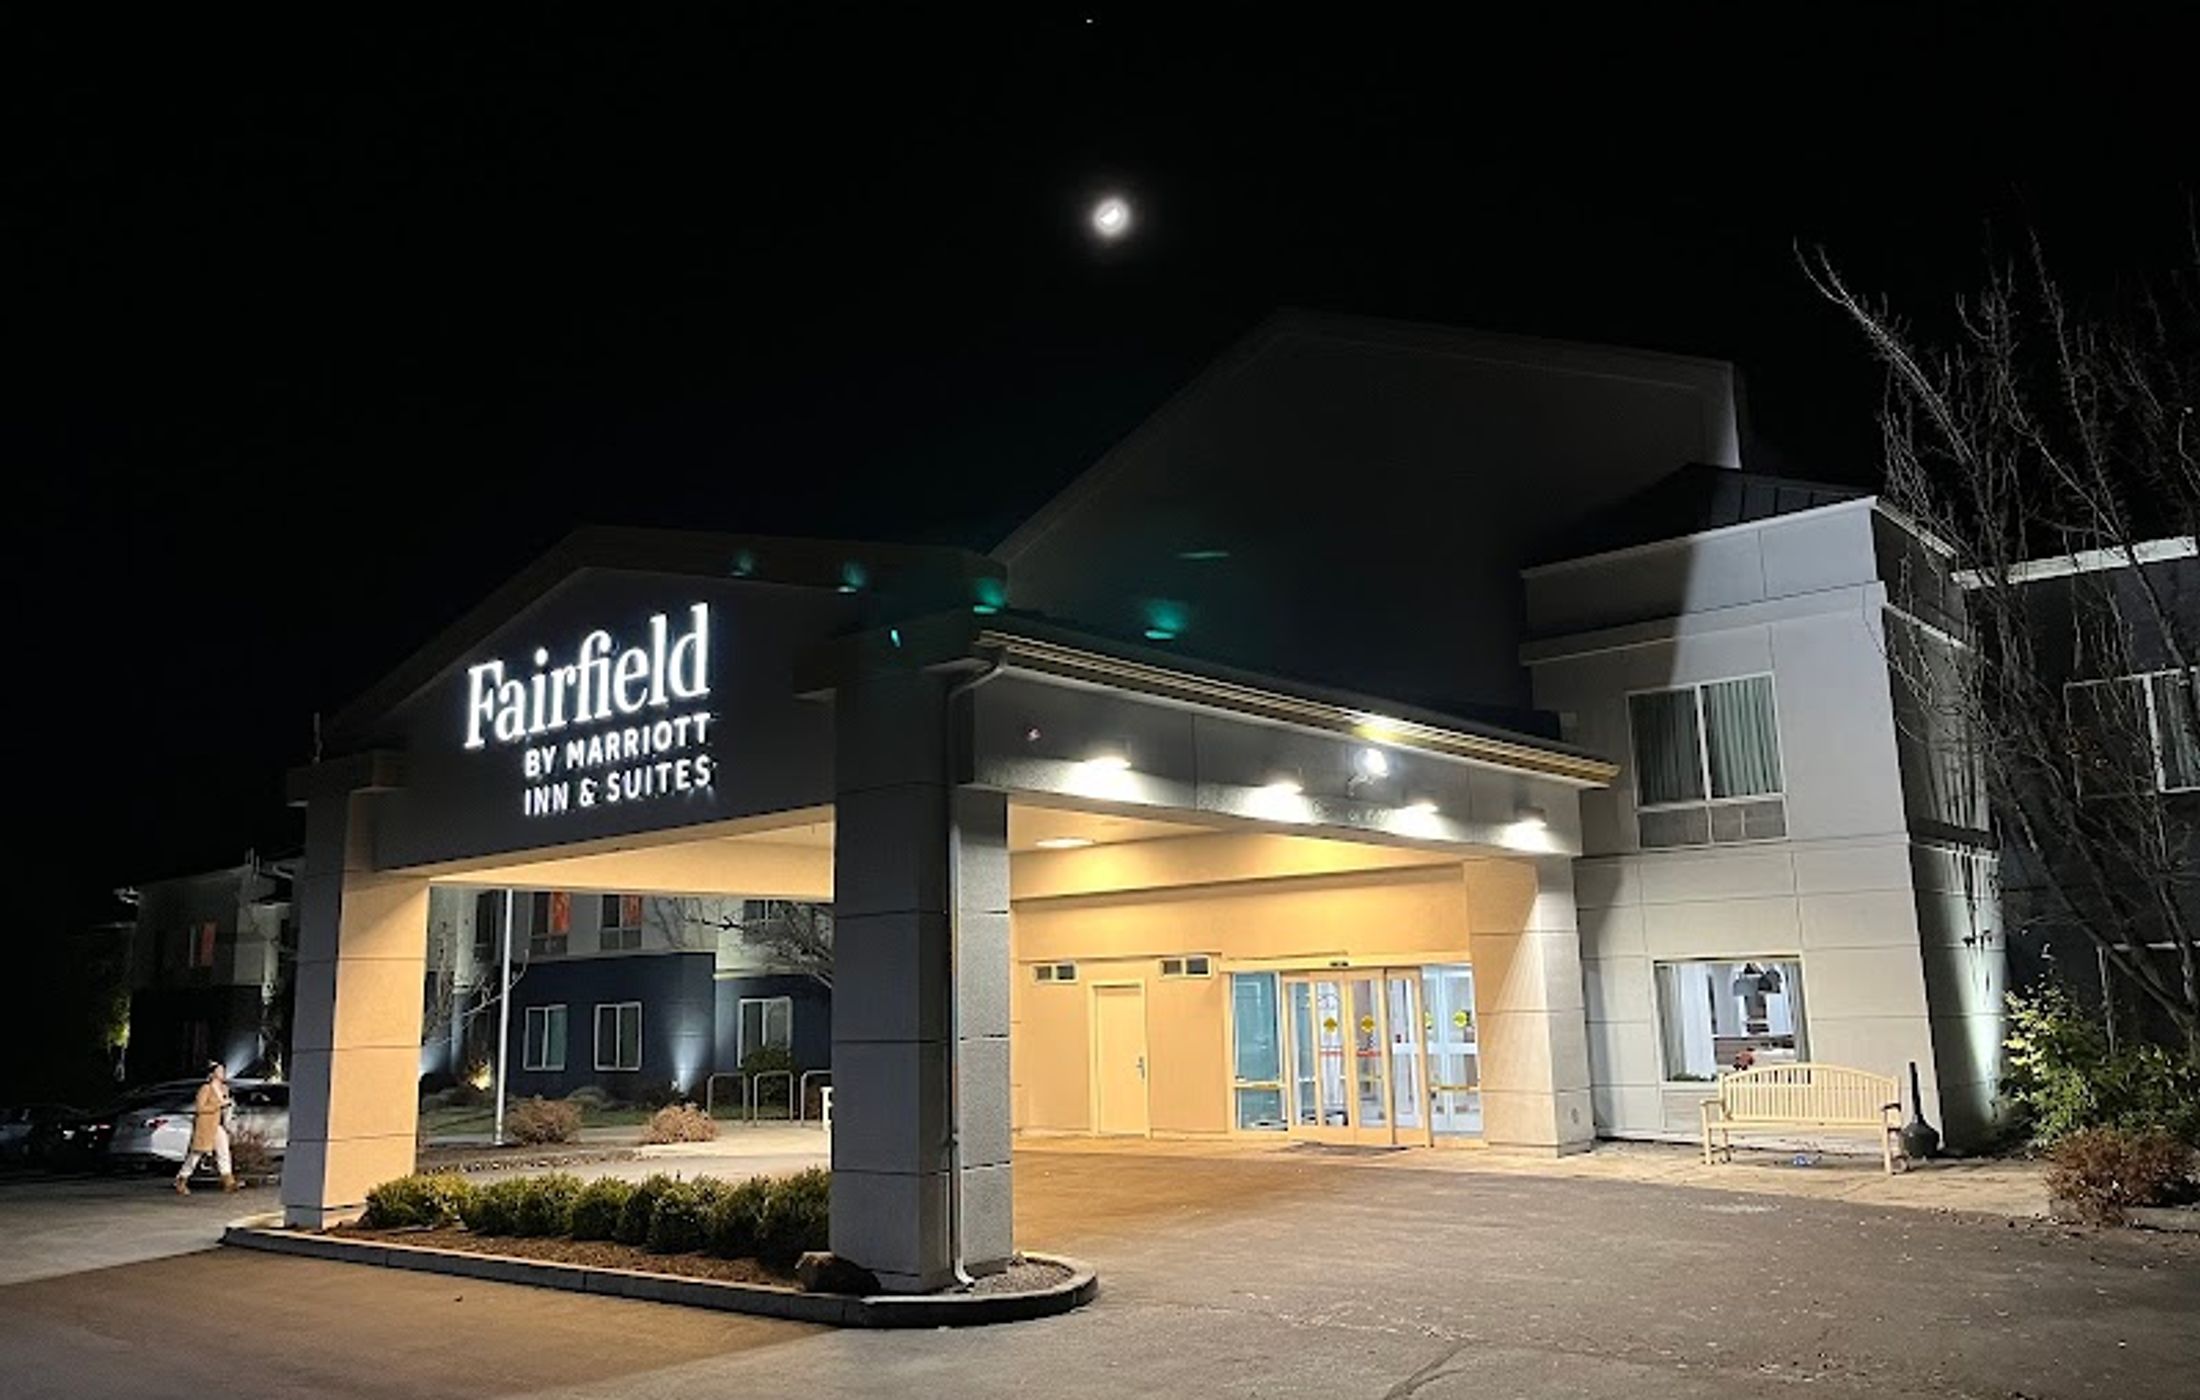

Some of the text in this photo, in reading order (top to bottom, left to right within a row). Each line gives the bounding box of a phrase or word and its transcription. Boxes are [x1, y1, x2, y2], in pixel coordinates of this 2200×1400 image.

[464, 602, 711, 749] Fairfield
[524, 712, 711, 777] BY MARRIOTT
[524, 755, 711, 816] INN & SUITES
